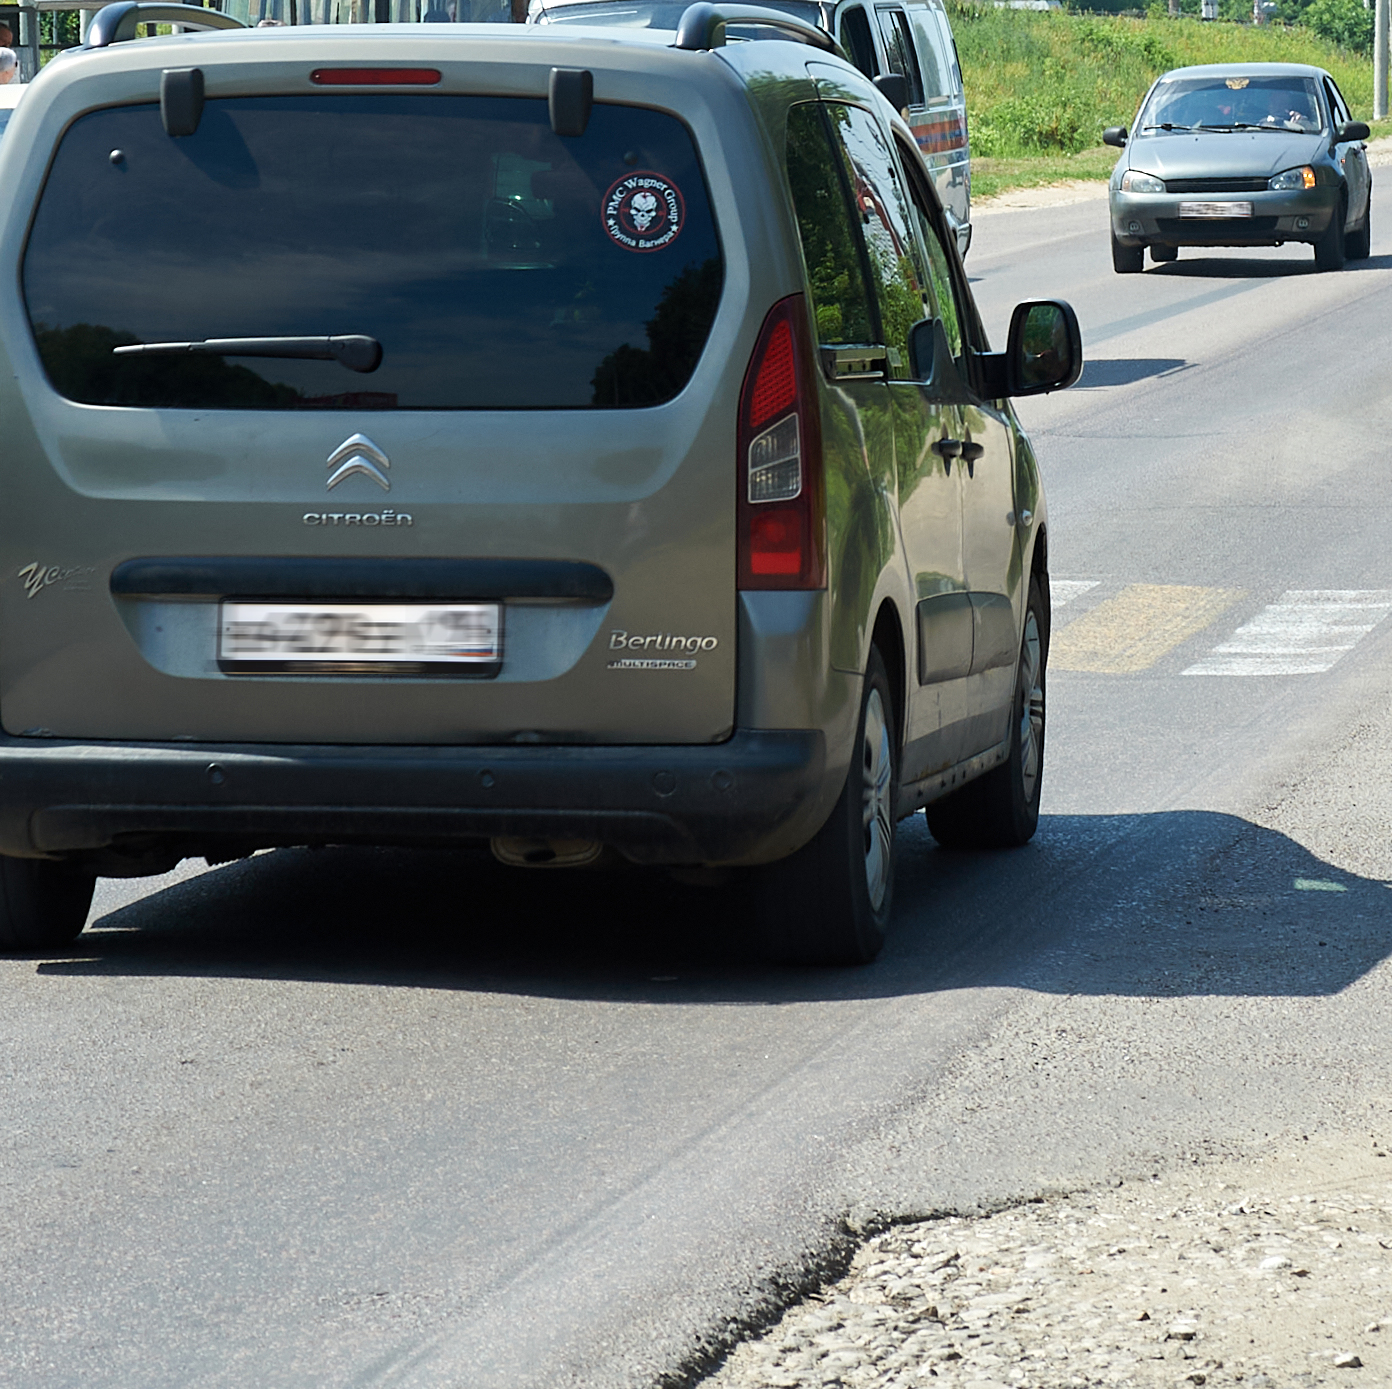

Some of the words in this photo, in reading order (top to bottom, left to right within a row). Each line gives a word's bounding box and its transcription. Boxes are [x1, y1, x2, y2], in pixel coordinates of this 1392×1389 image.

[607, 186, 627, 215] PMC
[623, 176, 668, 191] Wagner
[664, 189, 679, 223] Group
[608, 629, 719, 655] Berlingo
[608, 659, 694, 669] MULTISPACE
